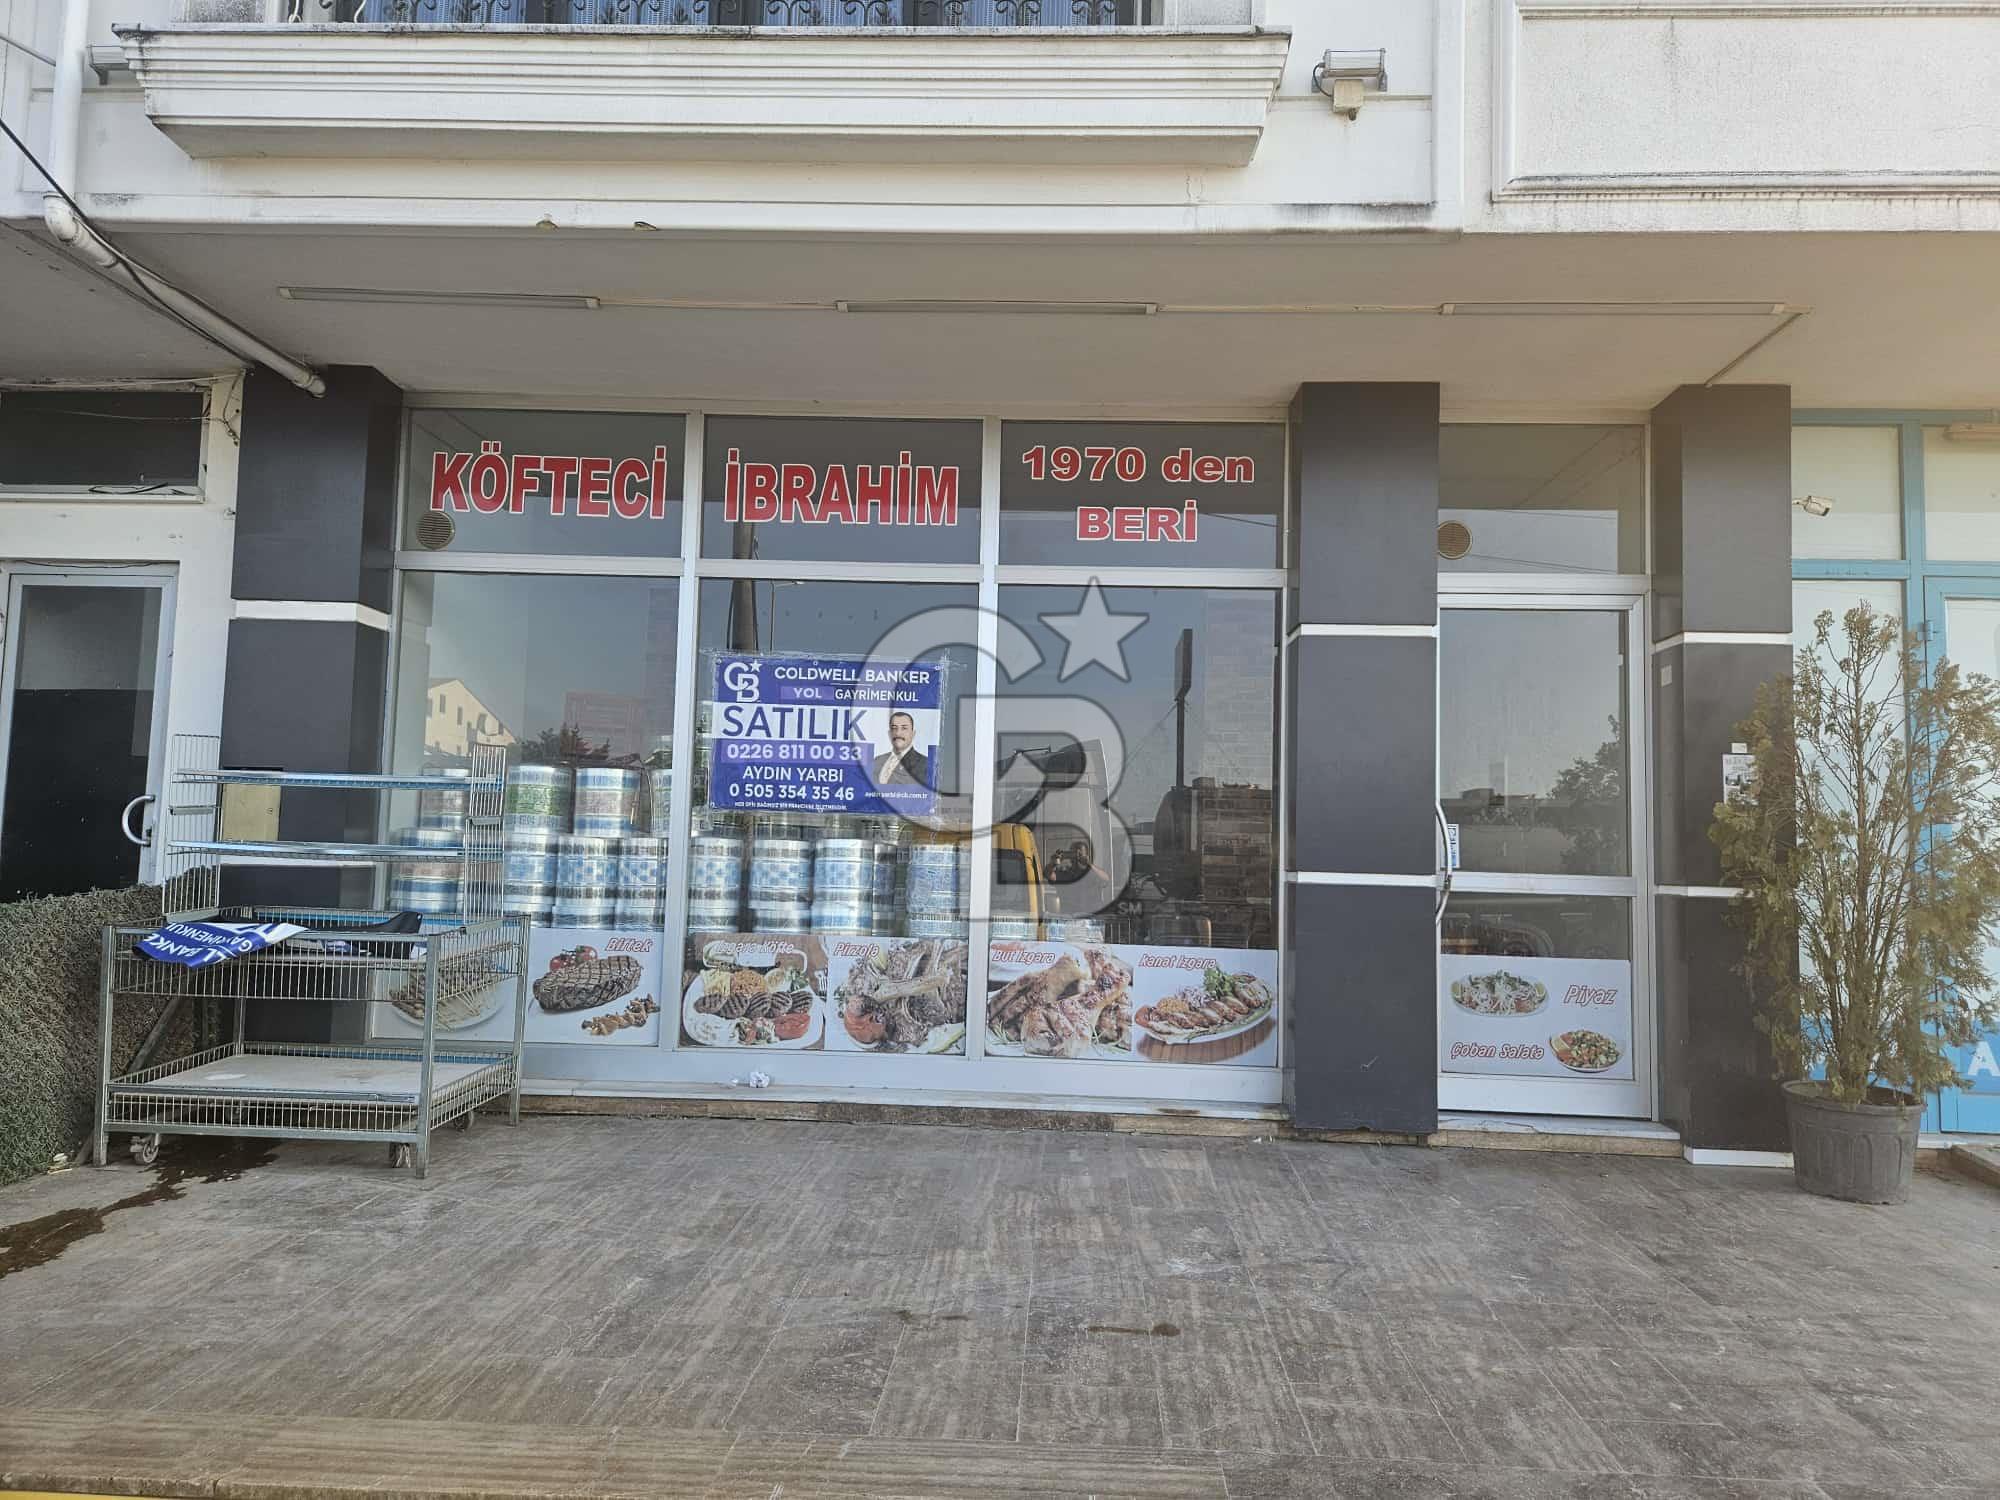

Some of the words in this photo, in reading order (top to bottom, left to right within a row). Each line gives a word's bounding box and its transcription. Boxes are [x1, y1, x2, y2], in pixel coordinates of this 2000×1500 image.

[1023, 445, 1147, 482] 1970
[1162, 448, 1255, 483] den
[431, 441, 666, 519] KÖFTECİ
[724, 448, 960, 526] İBRAHİM
[1076, 499, 1198, 542] BERİ
[774, 666, 861, 683] COLDWELL
[865, 670, 930, 684] BANKER
[793, 687, 823, 699] YOL
[835, 688, 919, 702] GAYRİMENKUL
[722, 705, 867, 741] SATILIK
[727, 744, 774, 760] 0226
[778, 745, 805, 760] 811
[810, 745, 836, 760] 00
[839, 746, 862, 761] 33
[743, 766, 792, 781] AYDIN
[796, 767, 843, 782] YARBI
[729, 783, 739, 797] 0
[744, 784, 774, 798] 505
[778, 784, 807, 800] 354
[812, 786, 830, 800] 35
[835, 786, 855, 801] 46
[833, 943, 879, 957] Pirzola
[1563, 984, 1618, 1007] Piyaz
